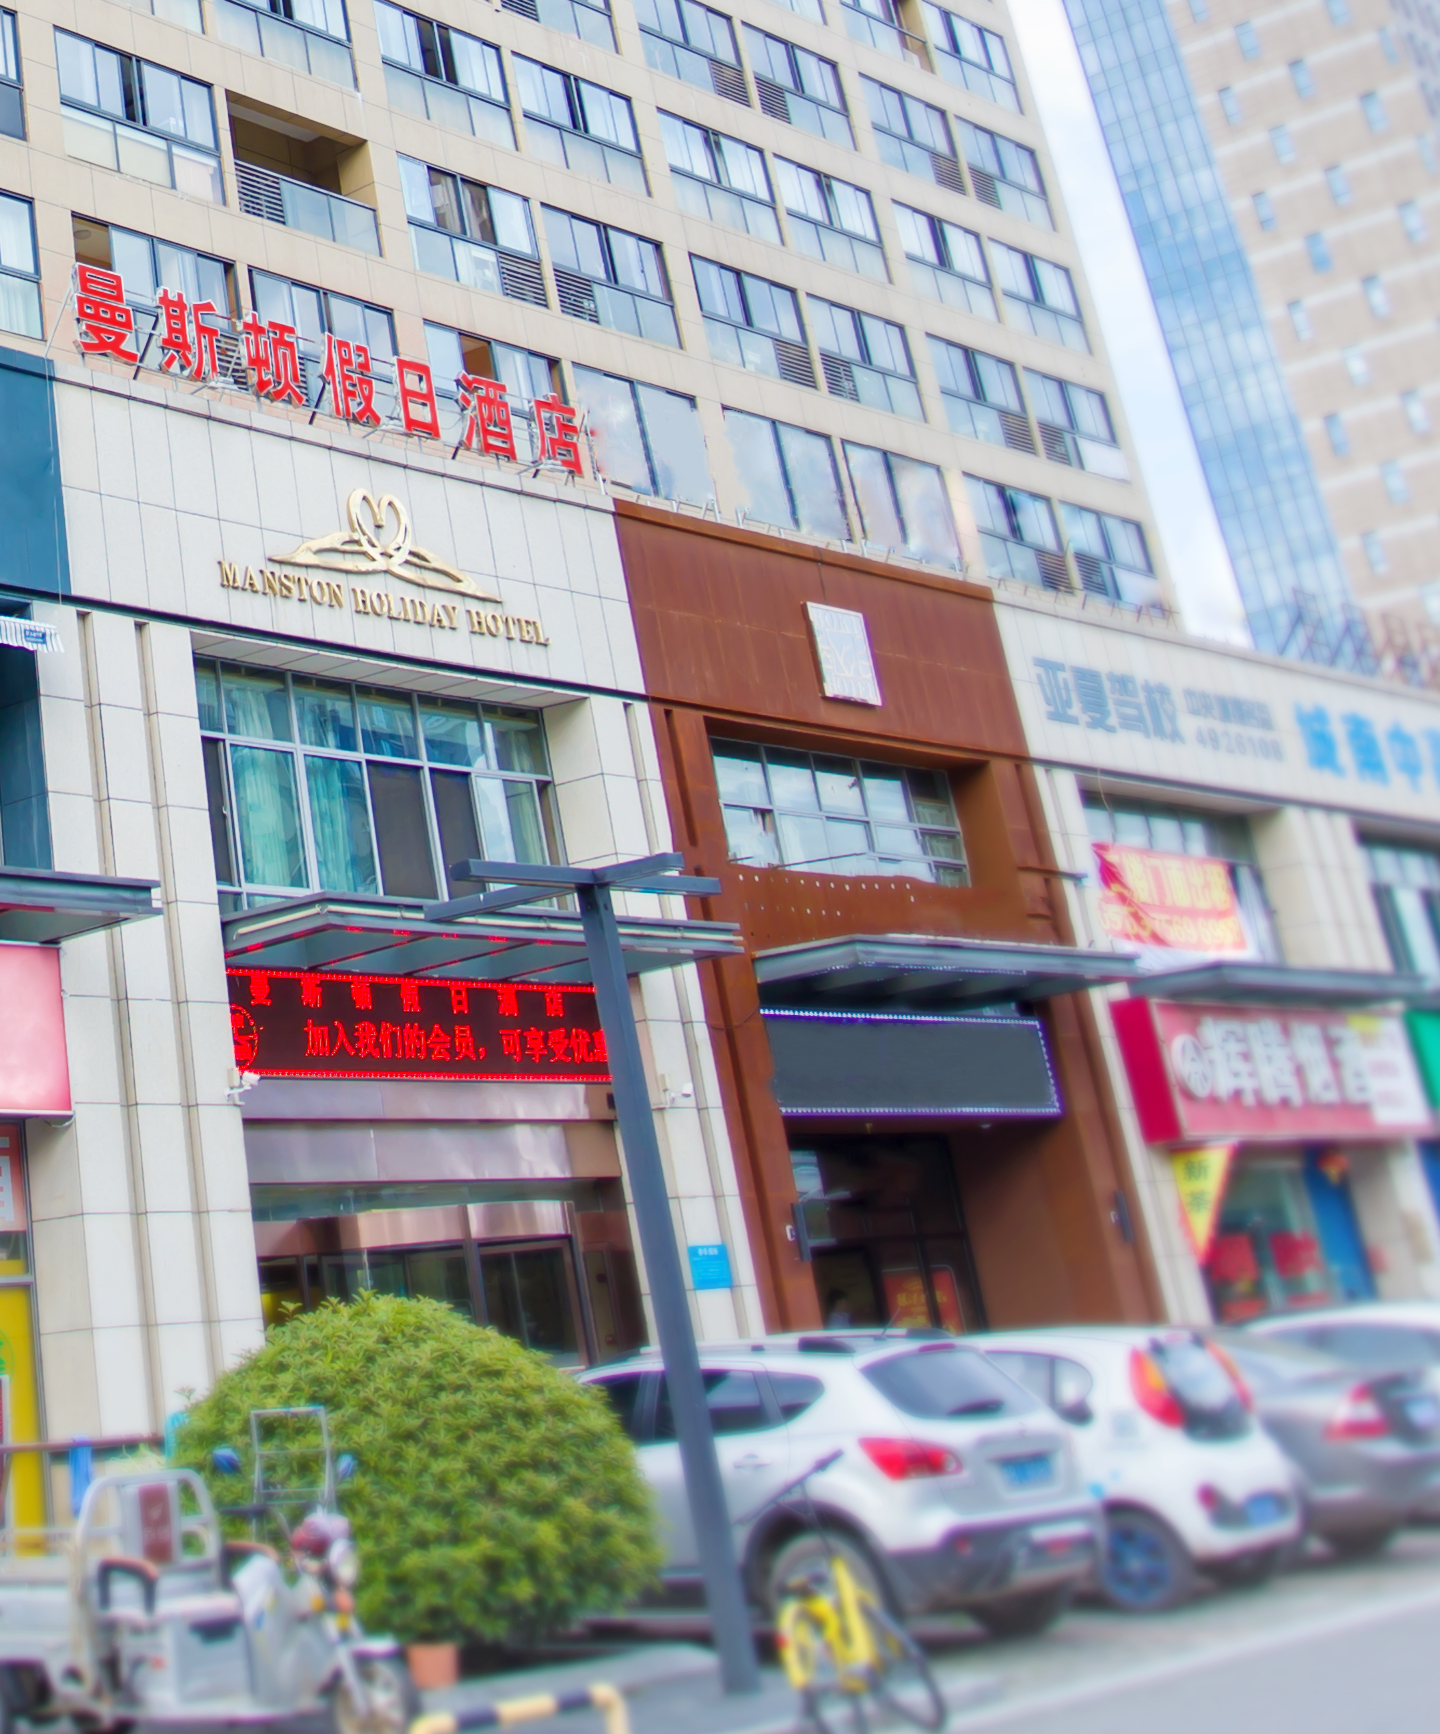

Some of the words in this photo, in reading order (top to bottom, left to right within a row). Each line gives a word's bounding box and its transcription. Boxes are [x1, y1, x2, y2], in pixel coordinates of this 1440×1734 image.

[73, 261, 585, 477] 曼斯顿假日酒店
[218, 560, 344, 609] MANSTON
[351, 587, 460, 630] HOLIDAY
[466, 609, 551, 646] HOTEL
[1033, 656, 1186, 745] 亚夏驾校
[1195, 725, 1284, 762] 4926108
